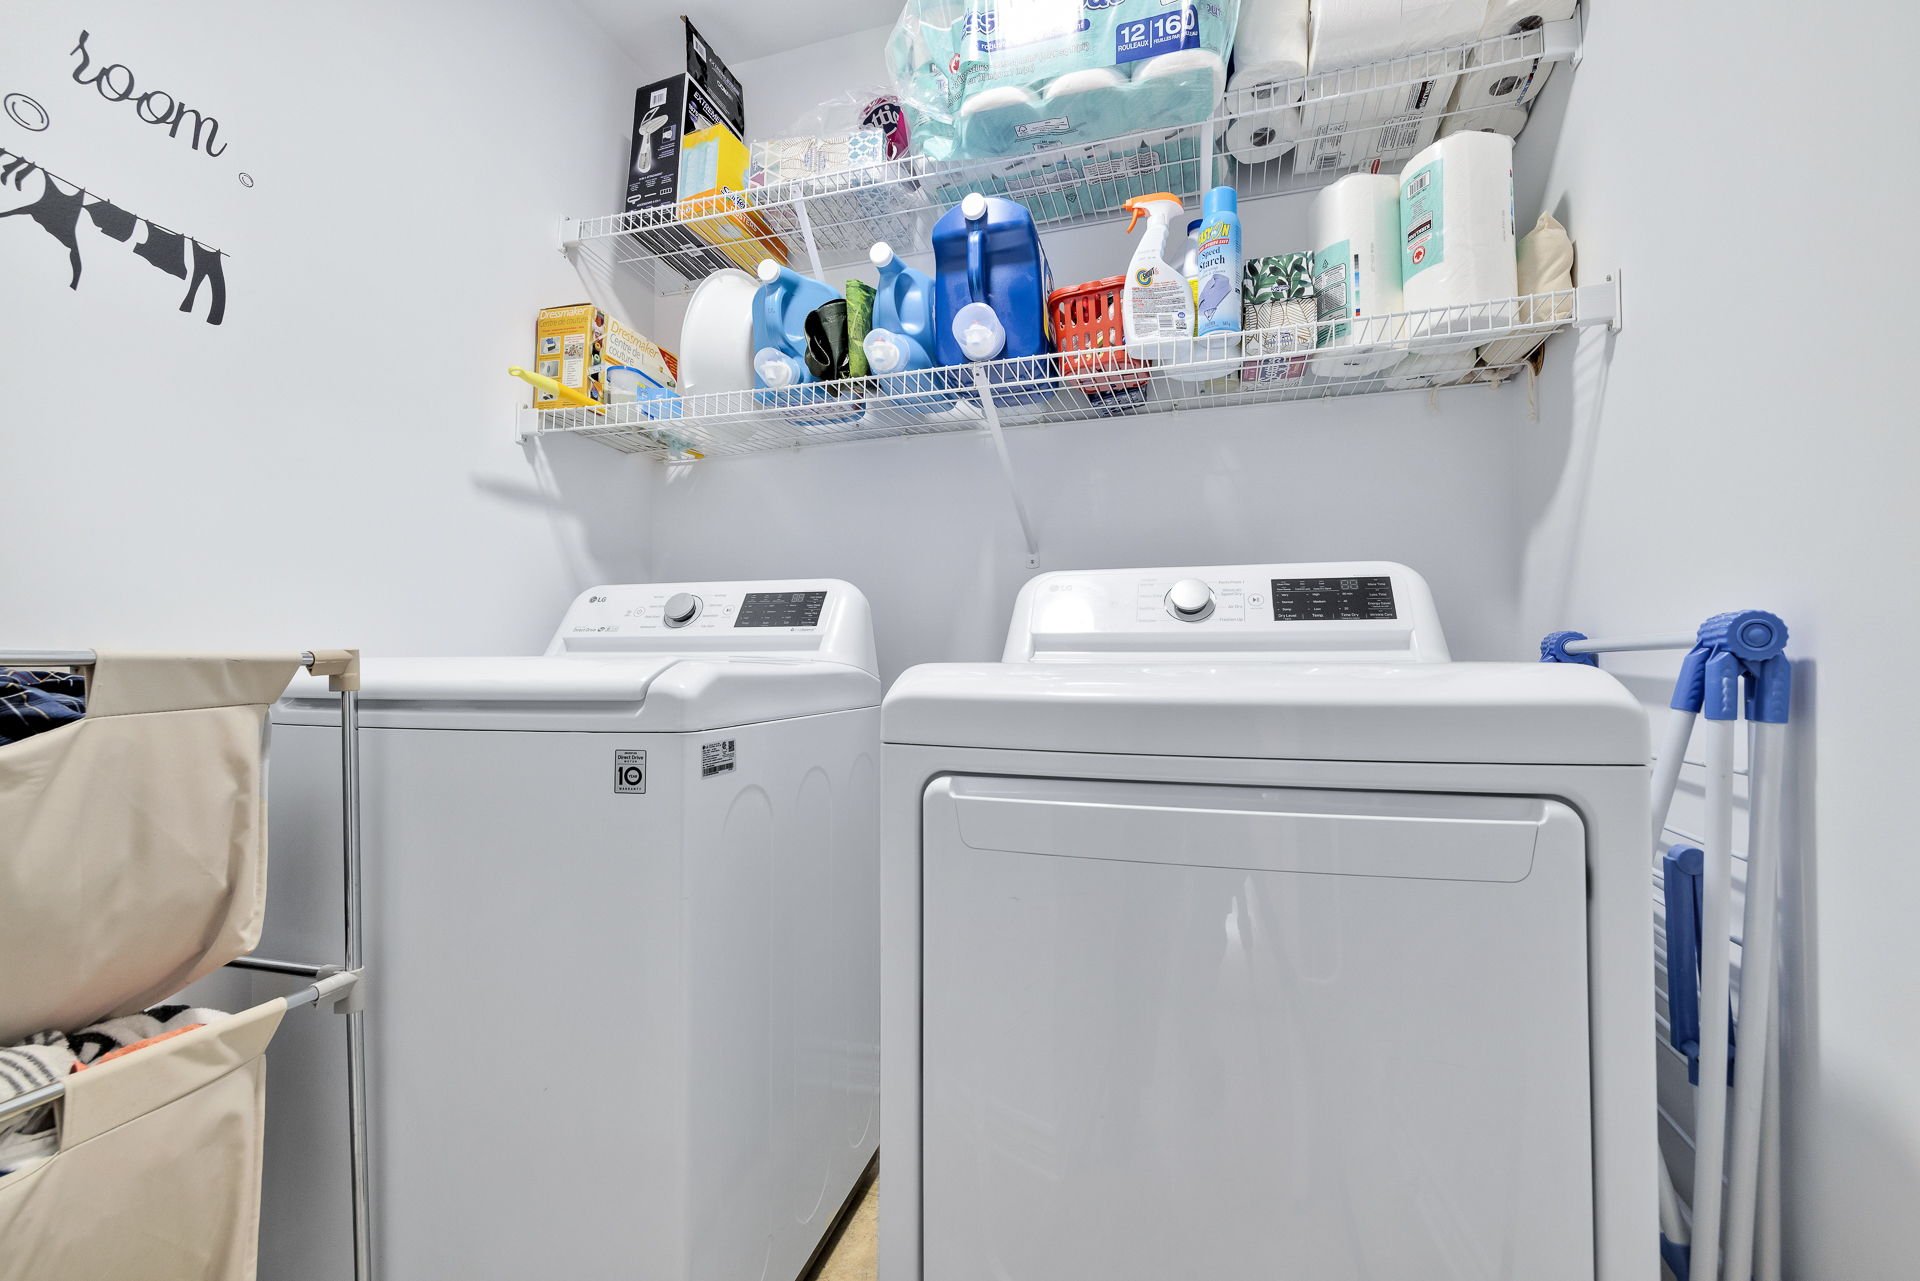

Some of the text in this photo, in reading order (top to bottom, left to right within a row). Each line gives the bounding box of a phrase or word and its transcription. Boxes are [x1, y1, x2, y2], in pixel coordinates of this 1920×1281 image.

[1121, 24, 1145, 43] 12
[1154, 9, 1195, 37] 160
[1117, 40, 1149, 52] ROULEAUX
[1153, 35, 1171, 44] FEUILLES
[70, 30, 228, 158] room
[693, 91, 721, 123] EXTREME
[1199, 254, 1226, 271] Starch
[1201, 247, 1221, 259] Speed
[540, 307, 585, 319] Dressmaker
[540, 319, 557, 328] Centre
[566, 316, 589, 326] couture
[610, 321, 659, 358] Dressmaker
[610, 333, 641, 358] Centre de
[608, 345, 635, 366] couture
[618, 766, 643, 786] 10
